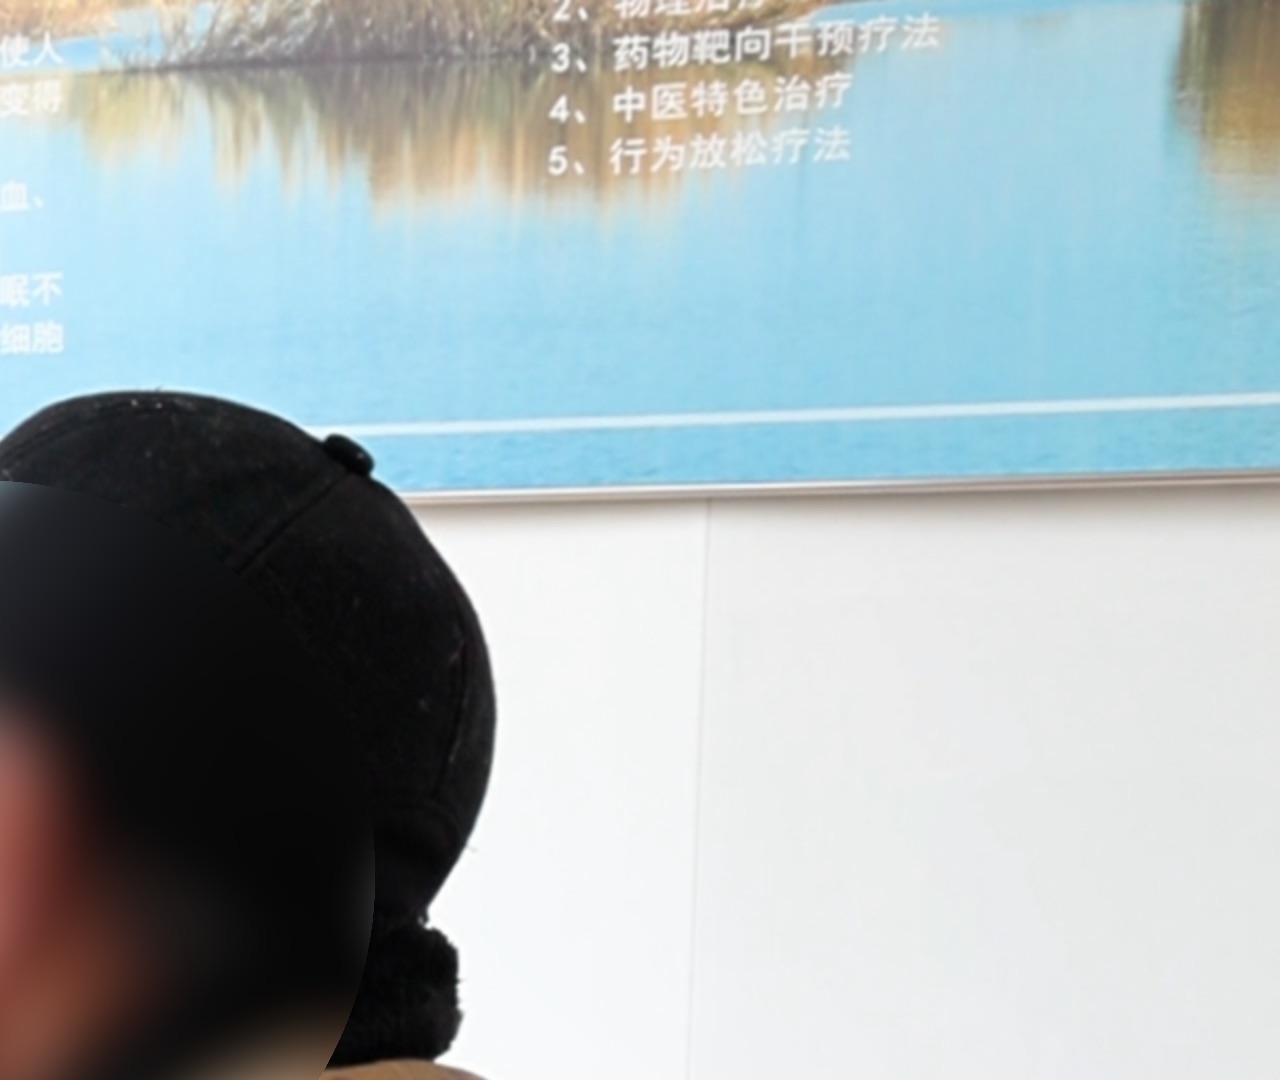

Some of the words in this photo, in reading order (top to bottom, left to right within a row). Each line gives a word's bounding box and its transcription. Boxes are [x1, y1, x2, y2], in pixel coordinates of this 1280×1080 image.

[551, 13, 940, 73] 3、药物靶向干预疗法
[549, 71, 853, 125] 4、中医特色治疗
[548, 126, 852, 177] 5、行为放松疗法
